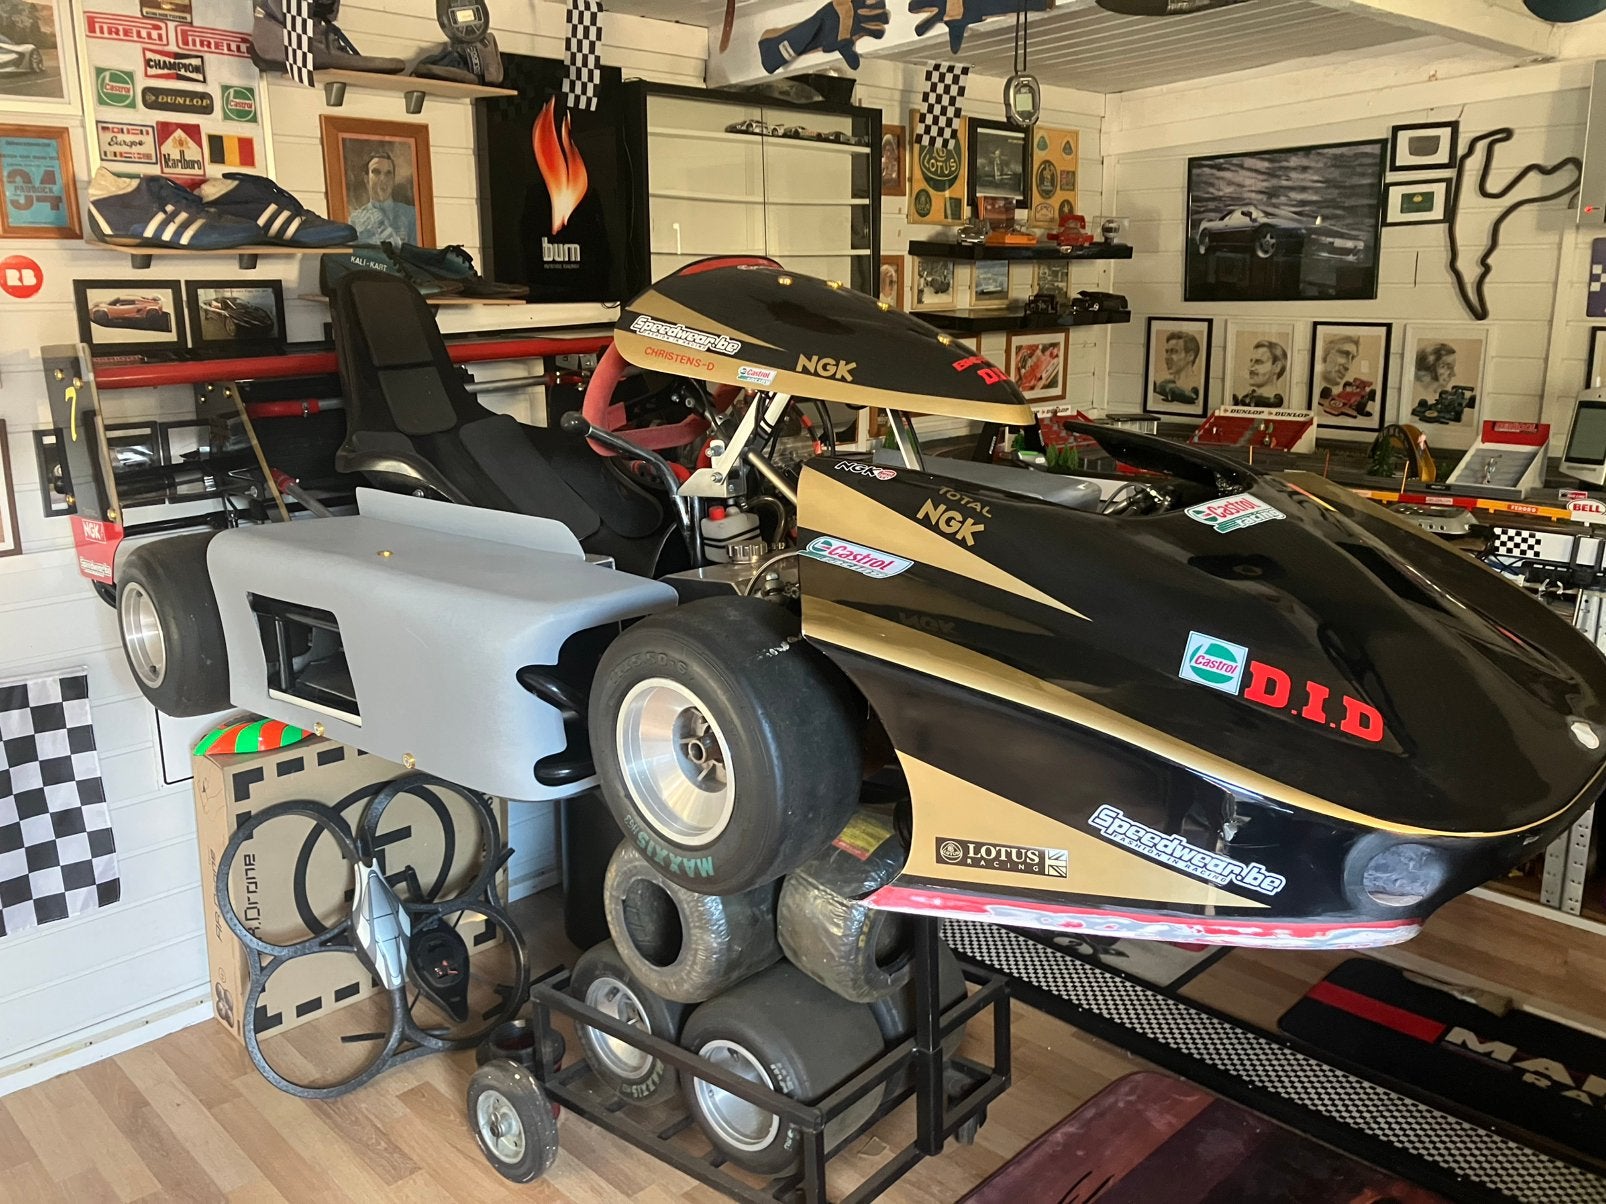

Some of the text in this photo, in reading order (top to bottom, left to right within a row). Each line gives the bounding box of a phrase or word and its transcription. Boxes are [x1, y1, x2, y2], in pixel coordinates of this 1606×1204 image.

[86, 15, 164, 42] PIRELLI
[147, 57, 203, 74] CHAMPION
[104, 83, 131, 95] Castrol
[158, 95, 211, 107] DUNLOP
[229, 100, 253, 110] Castrol
[108, 135, 145, 149] Europe
[163, 149, 202, 170] Marlboro
[924, 154, 957, 175] LOTUS
[7, 167, 63, 211] 34
[541, 236, 581, 262] burn
[5, 268, 37, 286] RB
[632, 316, 741, 354] Speedwear.be
[644, 346, 715, 371] CHRISTENS-D
[795, 353, 858, 383] NGK
[746, 368, 771, 379] Castrol
[1230, 408, 1265, 416] DUNLOP
[834, 460, 883, 478] NGK
[937, 485, 993, 519] TOTAL
[1206, 497, 1261, 519] Castrol
[1572, 503, 1601, 513] BELL
[83, 521, 101, 540] NGK
[916, 497, 985, 547] NGK
[827, 545, 895, 571] Castrol
[1194, 654, 1239, 675] Castrol
[1244, 660, 1384, 742] D.I.D
[636, 831, 715, 878] MAXXIS
[966, 843, 1040, 864] LOTUS
[1089, 805, 1285, 894] Speedwear.be
[1113, 833, 1228, 883] FASHION IN RACING
[966, 858, 1039, 873] RACING
